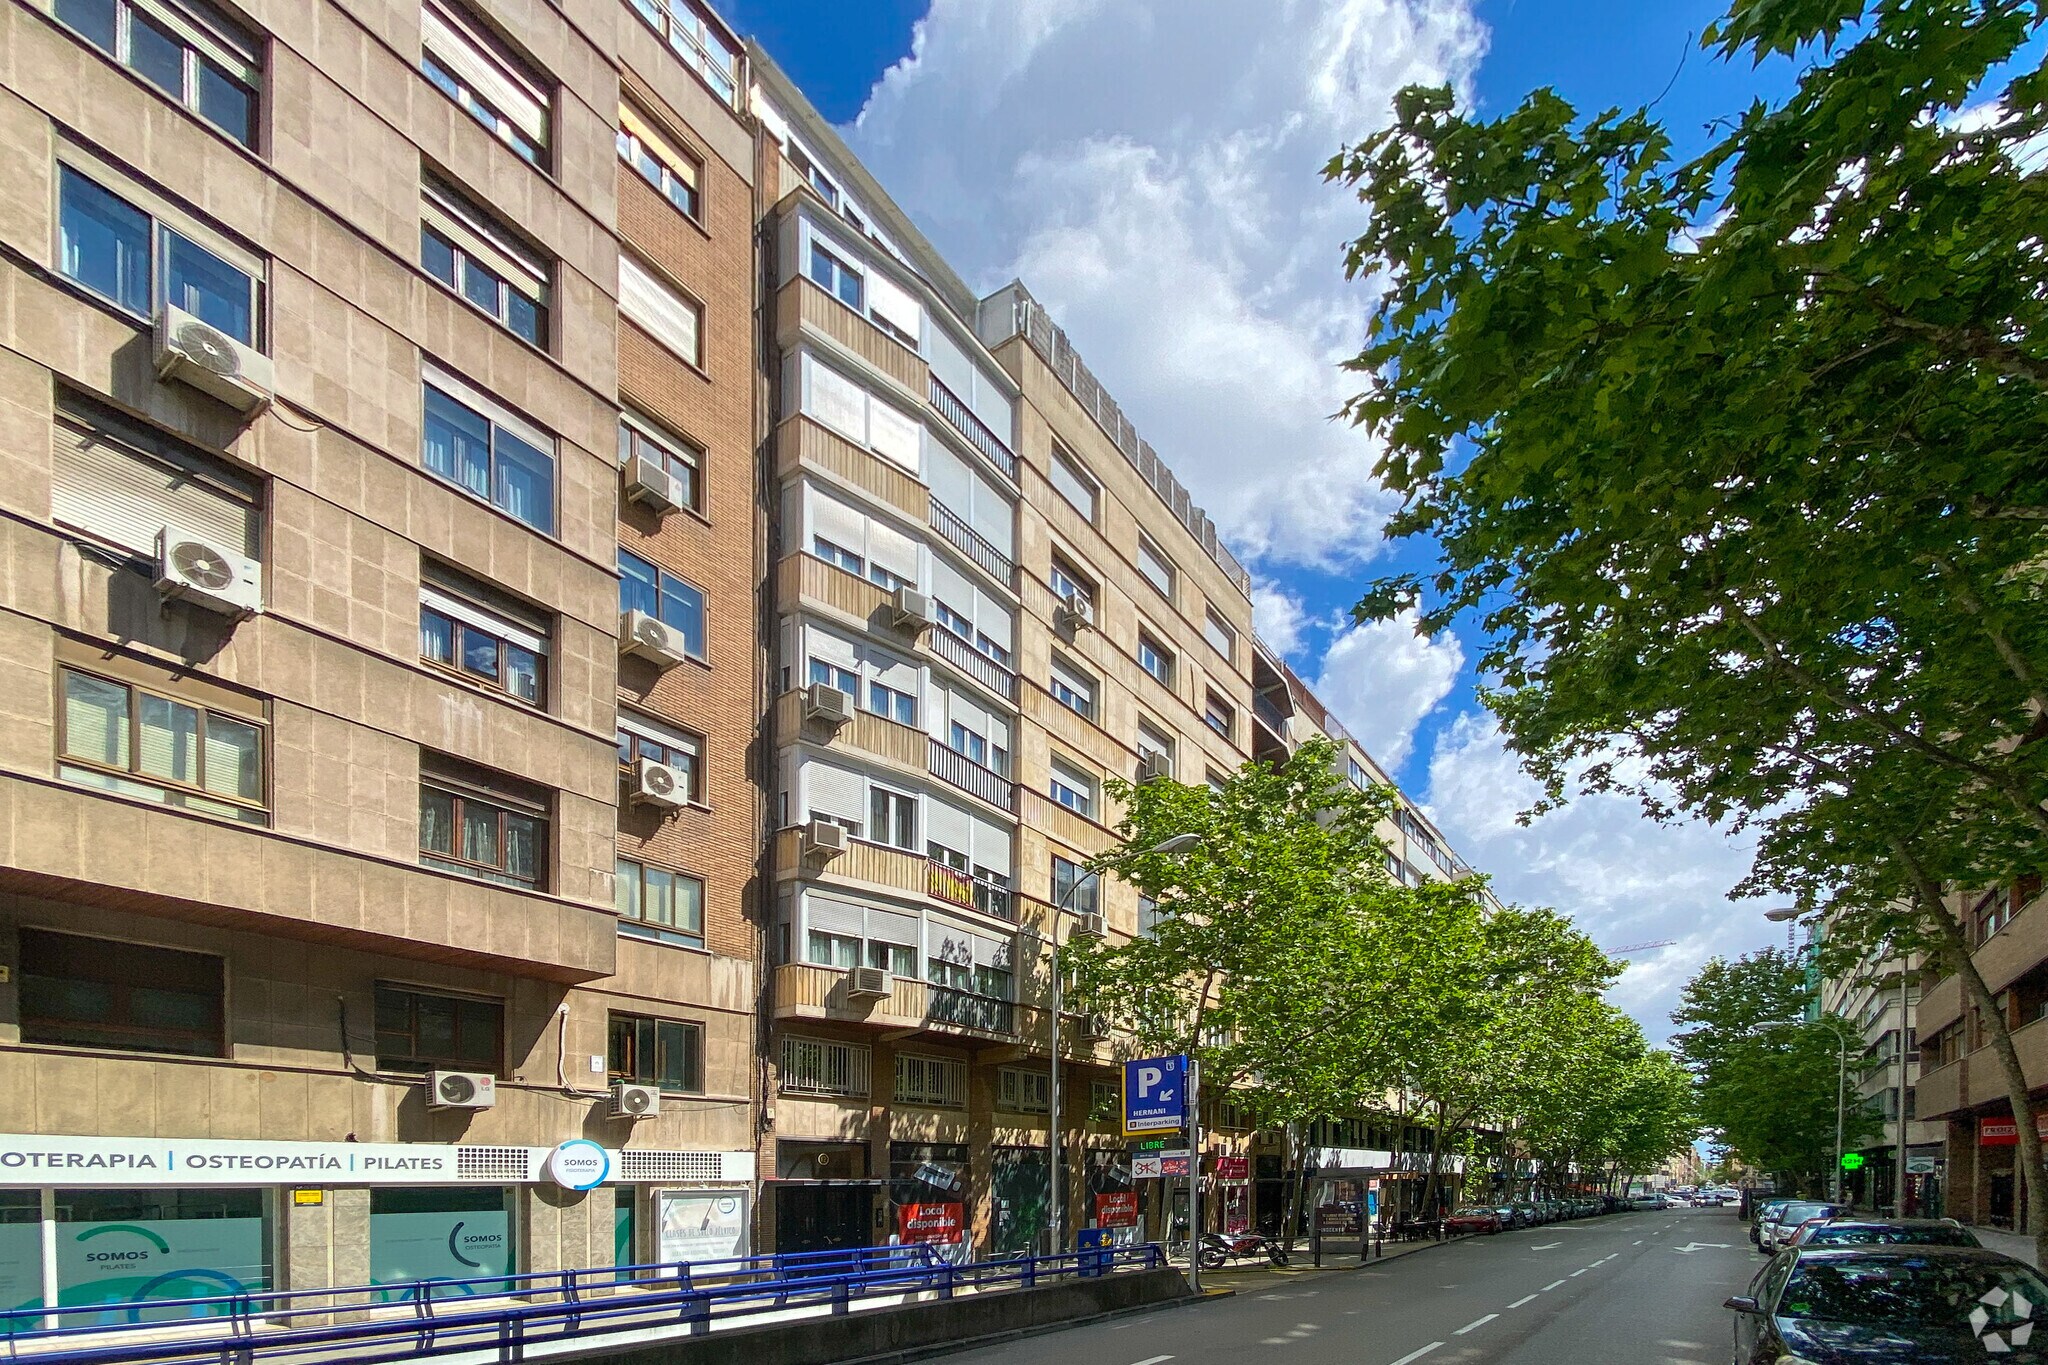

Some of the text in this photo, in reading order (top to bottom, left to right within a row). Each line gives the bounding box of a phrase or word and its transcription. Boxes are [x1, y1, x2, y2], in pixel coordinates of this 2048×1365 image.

[1138, 1067, 1162, 1098] P
[1133, 1107, 1166, 1117] HERNANI
[1137, 1118, 1180, 1128] Interparking
[1140, 1140, 1165, 1150] LIBRE
[0, 1151, 443, 1170] OTERAPIA OSTEOPATÍA PILATES
[1109, 1193, 1126, 1204] Local
[919, 1204, 945, 1216] Local
[1101, 1203, 1133, 1216] disponible
[906, 1216, 956, 1231] disponible
[463, 1234, 502, 1243] SOMOS
[86, 1250, 149, 1262] SOMOS
[100, 1262, 137, 1271] PILATES
